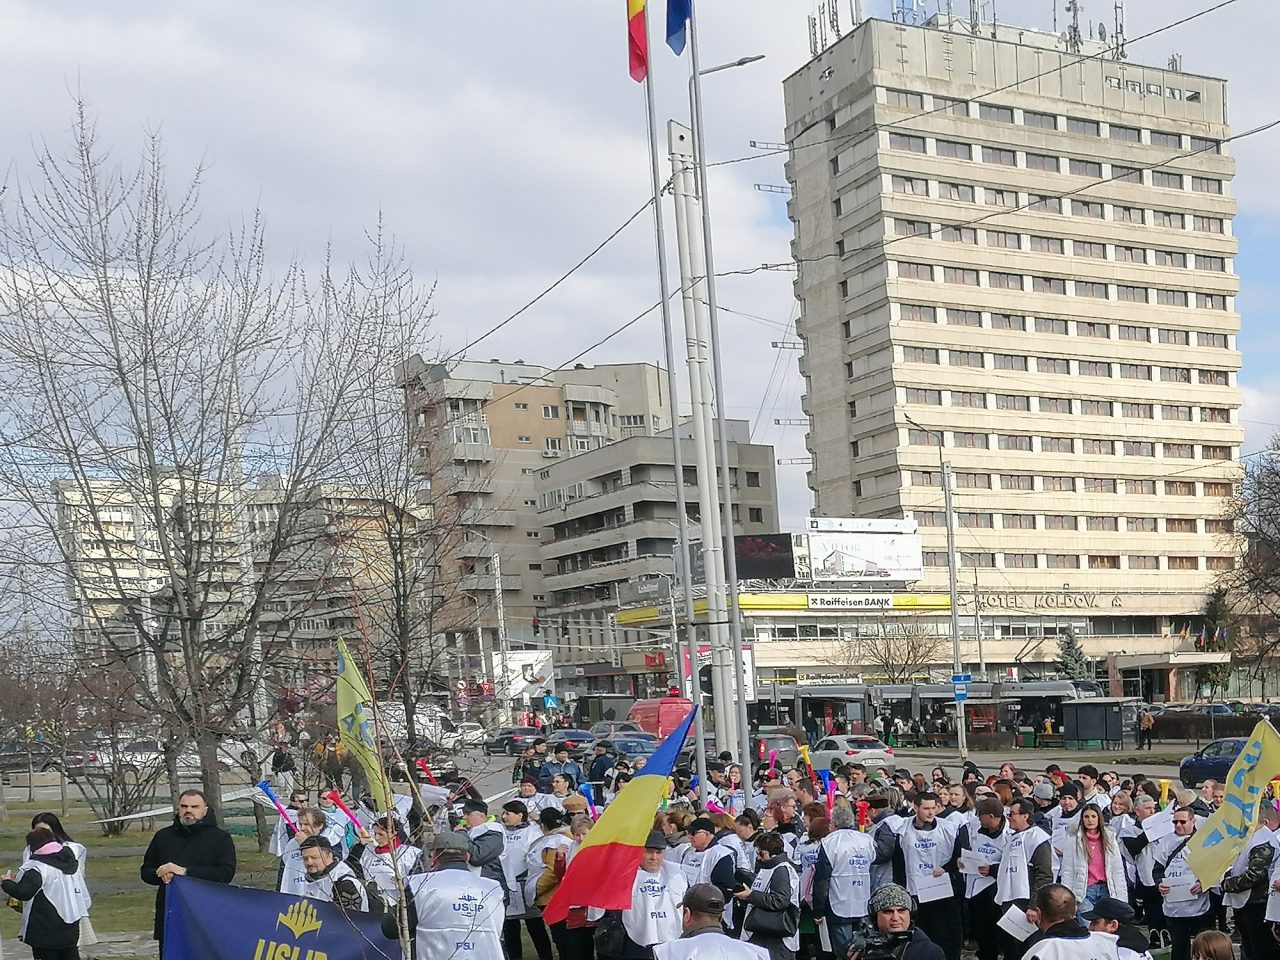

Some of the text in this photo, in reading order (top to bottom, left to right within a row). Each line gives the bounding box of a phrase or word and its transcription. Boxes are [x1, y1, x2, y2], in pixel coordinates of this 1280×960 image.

[820, 597, 890, 606] Raiffeisen BANK
[977, 594, 1100, 609] HOTEL MOLDOVA
